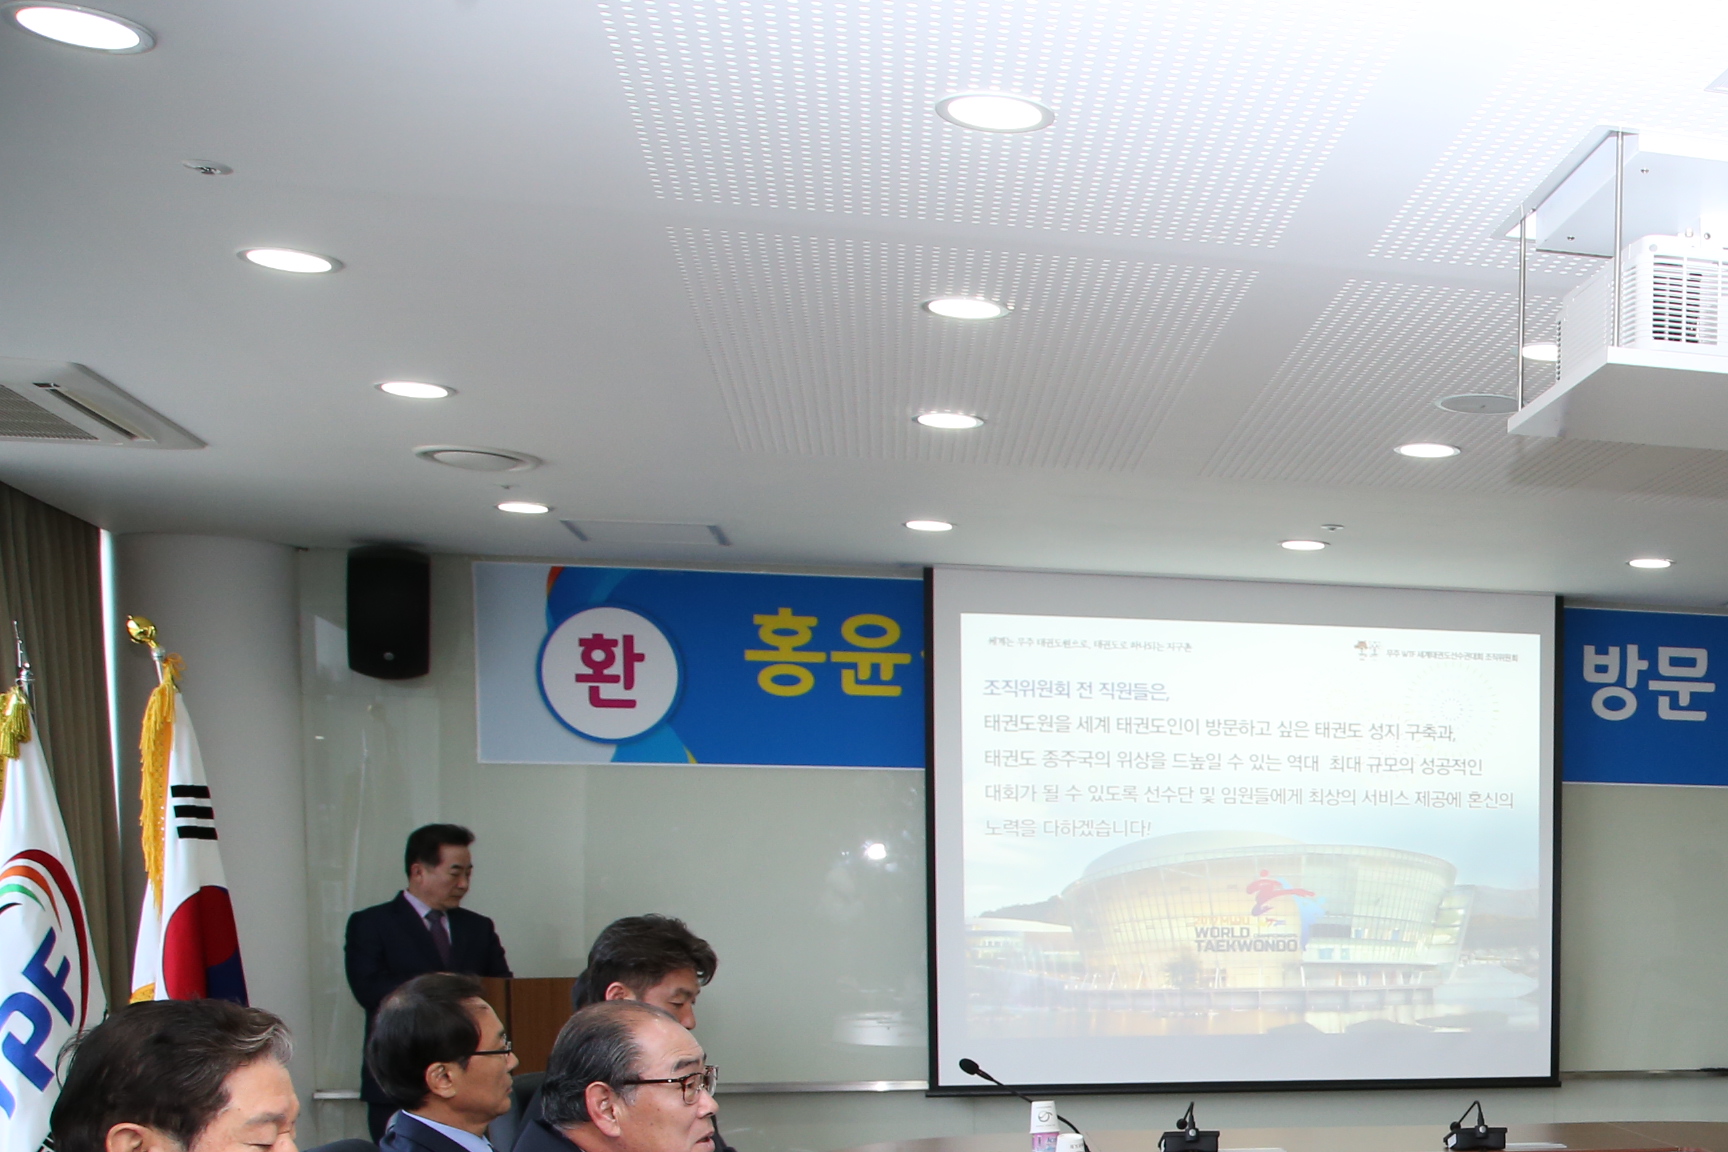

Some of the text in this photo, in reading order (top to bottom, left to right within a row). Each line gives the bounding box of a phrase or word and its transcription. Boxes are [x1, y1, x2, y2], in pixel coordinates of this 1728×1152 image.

[743, 606, 925, 698] 홍윤
[575, 632, 646, 709] 환
[1582, 643, 1717, 722] 방문
[983, 679, 1170, 702] 조직위원회 전 직원들은,
[984, 714, 1456, 743] 태권도원을 세계 태권도인이 방문하고 싶은 태권도 성지 구축과,
[984, 749, 1483, 776] 태권도 종주국의 위상을 드높일 수 있는 역대 최대 규모의 성공적인
[985, 783, 1514, 809] 대회가 될 수 있도록 선수단 및 임원들에게 최상의 서비스 제공에 혼신의
[984, 819, 1151, 838] 노력을 다하겠습니다!
[1194, 926, 1250, 938] WORLD
[1194, 938, 1298, 953] TAEKWONDO
[0, 926, 76, 1120] PF
